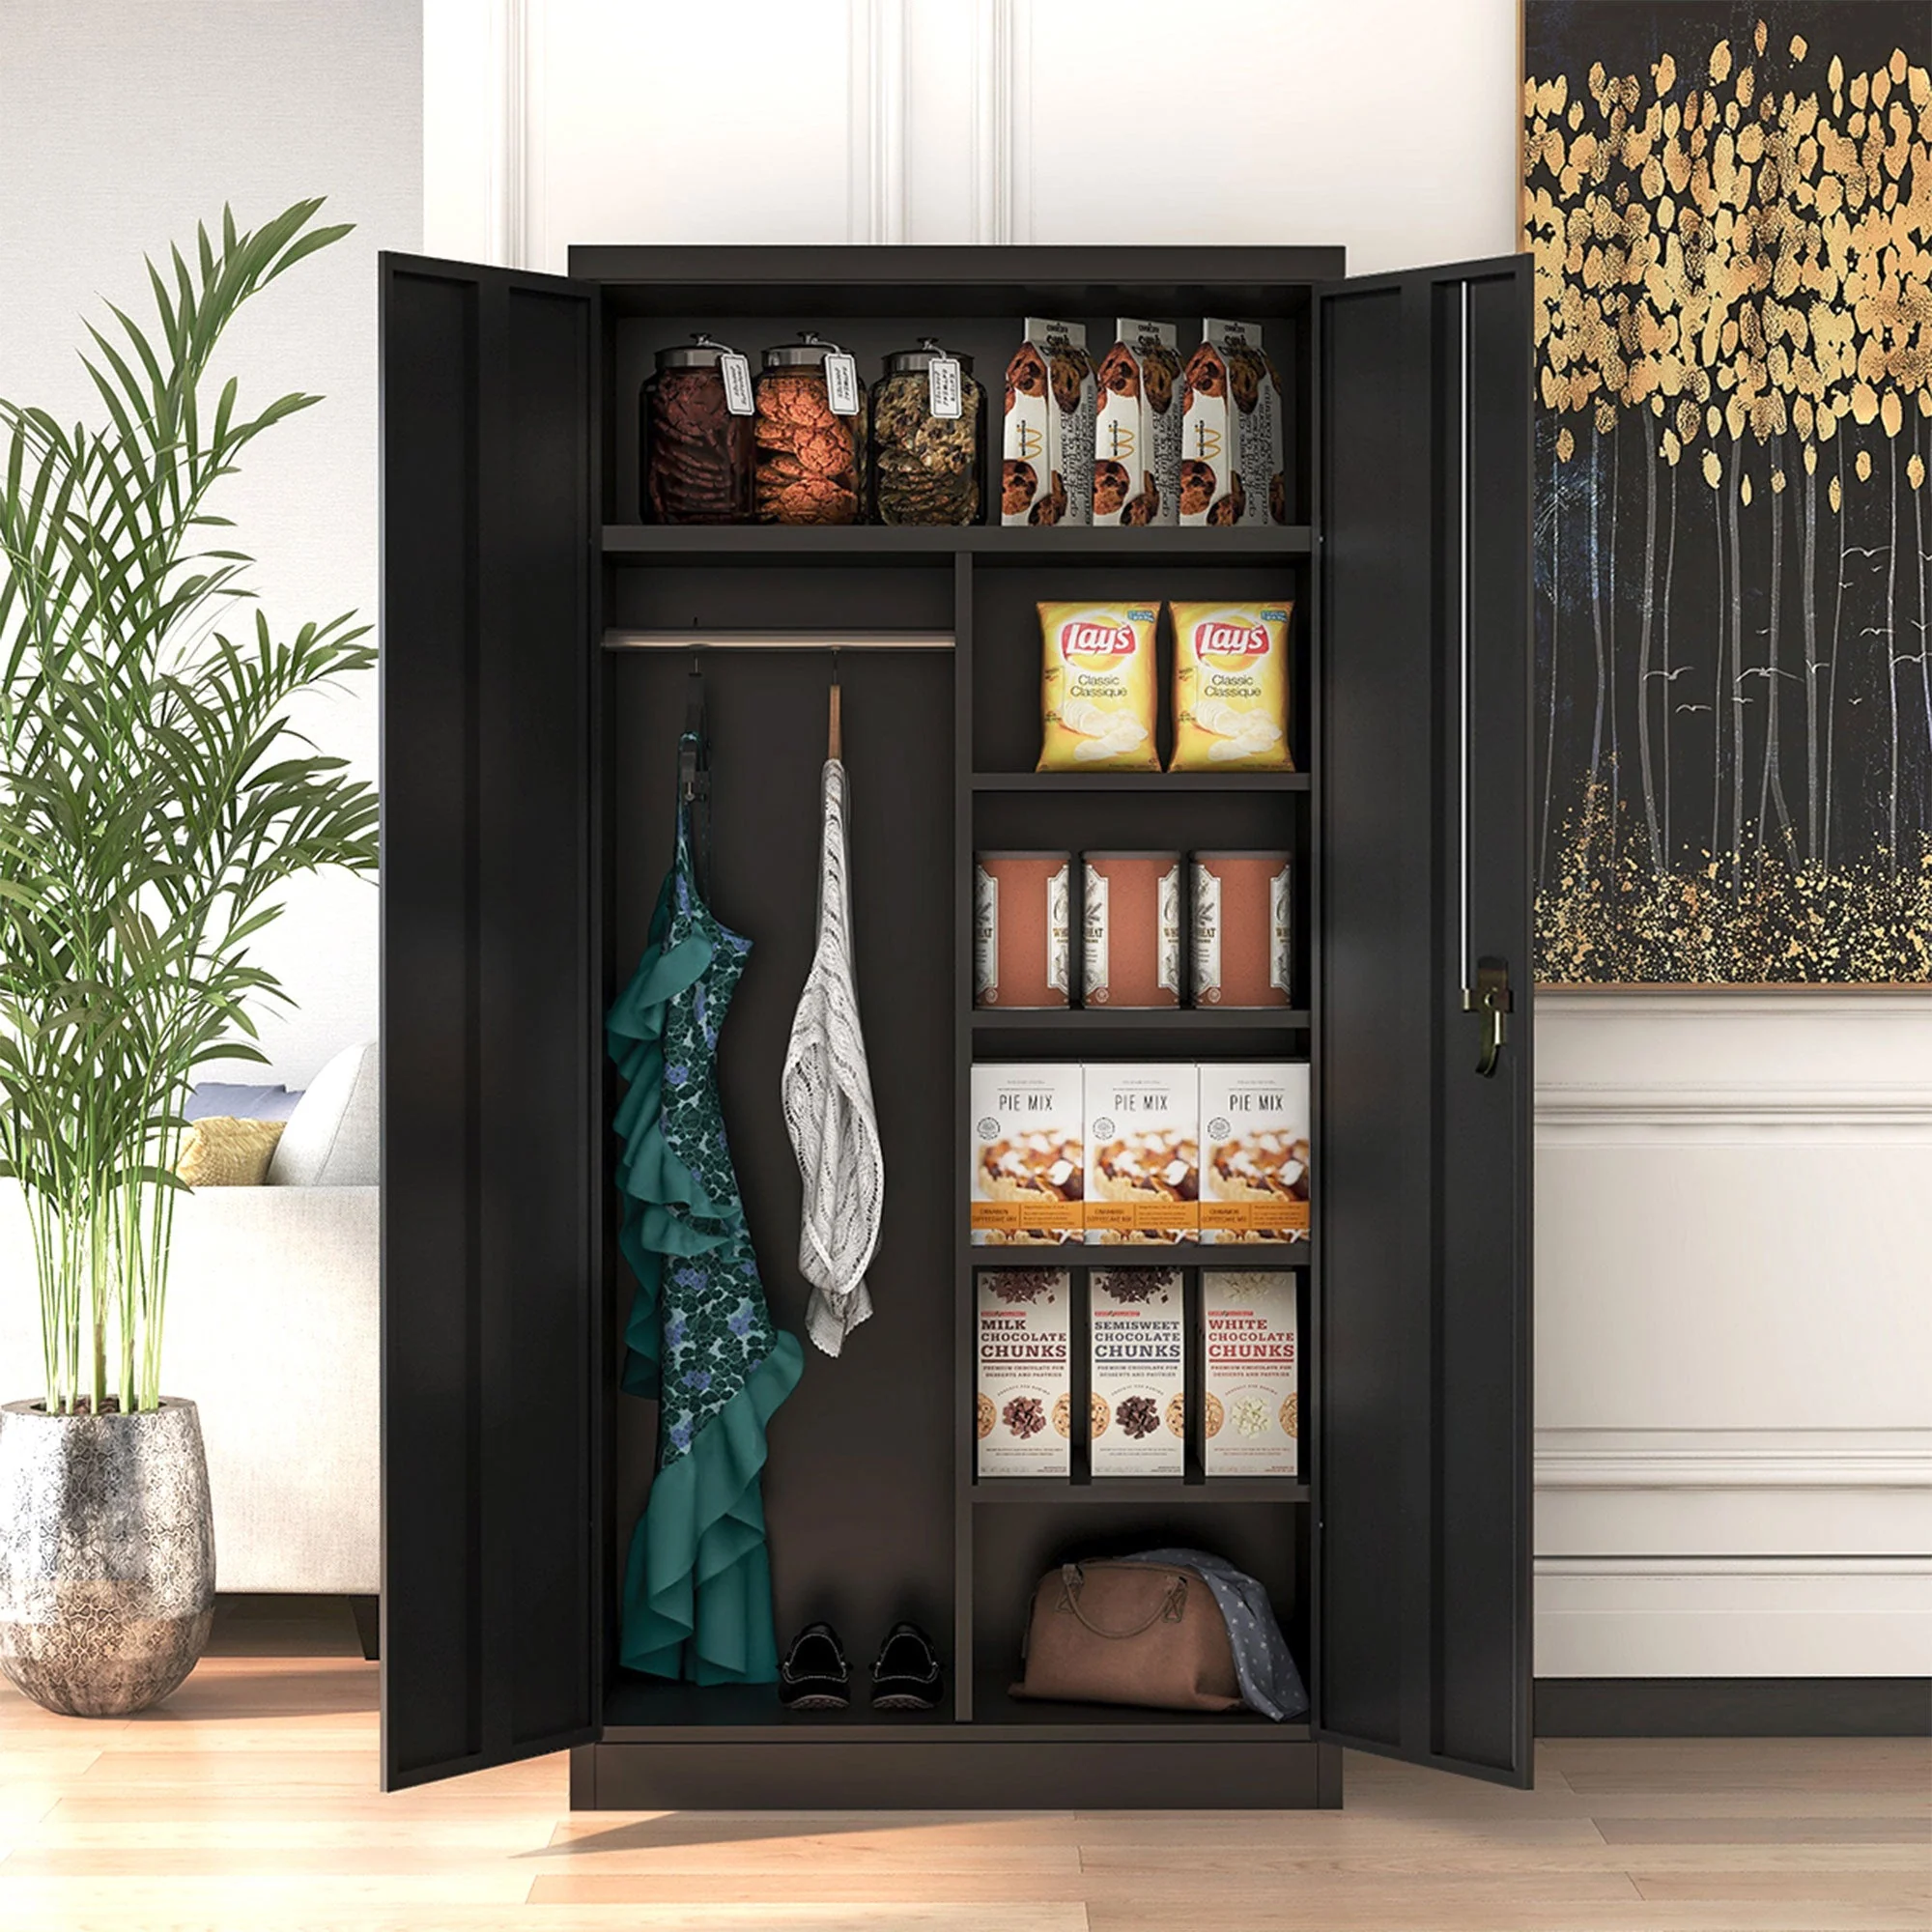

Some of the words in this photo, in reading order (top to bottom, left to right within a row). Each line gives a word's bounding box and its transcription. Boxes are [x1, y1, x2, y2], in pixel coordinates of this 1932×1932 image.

[1078, 674, 1119, 686] Classic
[1212, 674, 1253, 686] Classic
[1070, 686, 1127, 698] Classique
[1204, 686, 1261, 698] Classique
[999, 1094, 1020, 1111] PIE
[1028, 1094, 1053, 1111] MIX
[1115, 1094, 1136, 1111] PIE
[1144, 1094, 1167, 1111] MIX
[1230, 1094, 1251, 1111] PIE
[1259, 1094, 1283, 1111] MIX
[981, 1320, 1026, 1330] MILK
[1094, 1321, 1179, 1330] SEMISWEET
[1208, 1320, 1267, 1329] WHITE
[981, 1333, 1066, 1342] CHOCOLATE
[1094, 1333, 1180, 1342] CHOCOLATE
[1208, 1333, 1294, 1342] CHOCOLATE
[981, 1345, 1066, 1357] CHUNKS
[1094, 1345, 1180, 1357] CHUNKS
[1208, 1345, 1294, 1357] CHUNKS
